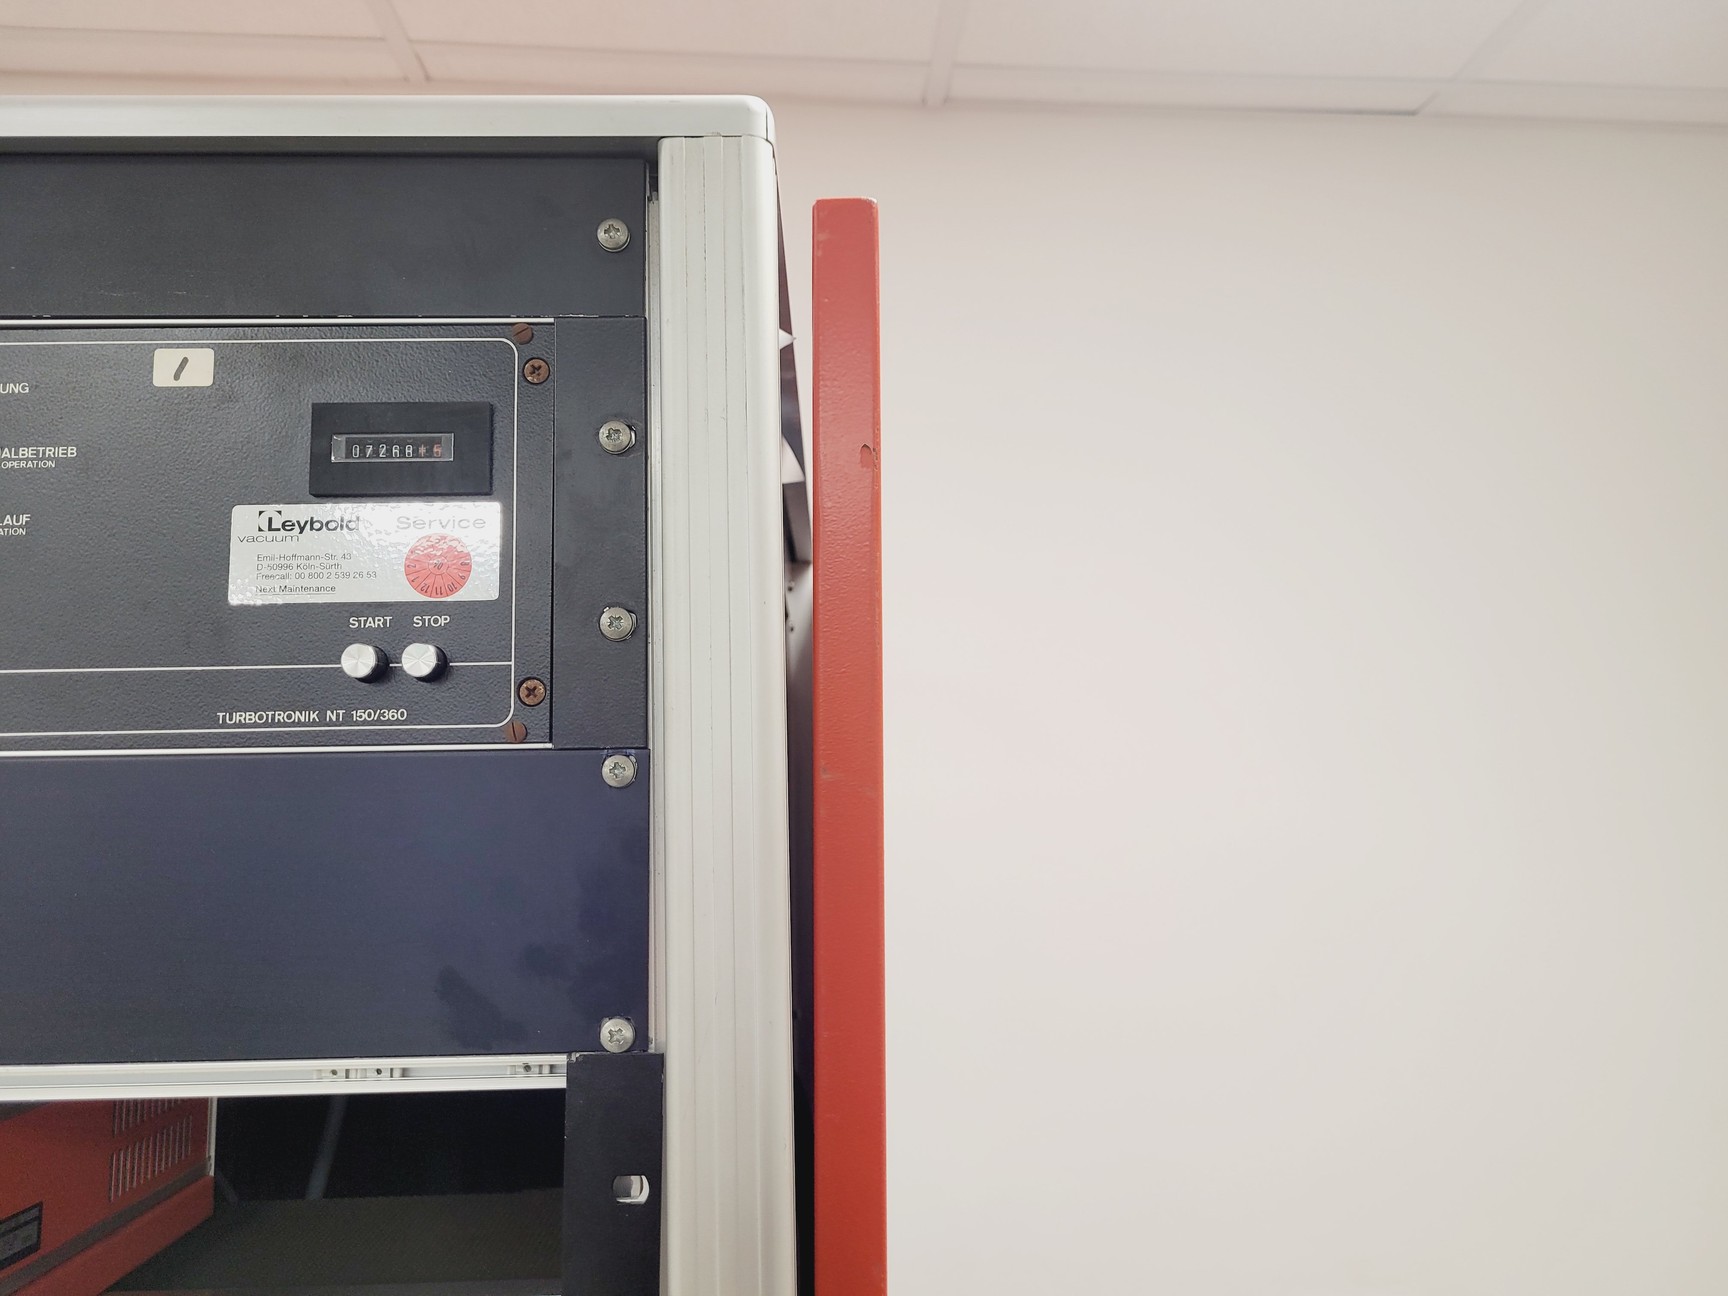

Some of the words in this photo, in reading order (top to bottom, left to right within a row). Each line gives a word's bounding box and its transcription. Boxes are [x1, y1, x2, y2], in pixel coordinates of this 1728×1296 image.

[0, 446, 77, 459] ALBETRIEB
[1, 460, 56, 469] OPERATION
[267, 516, 360, 535] Leybold
[396, 515, 487, 530] Service
[237, 534, 300, 543] vacuum
[256, 553, 339, 562] Emil-Hoffmann-Str.
[340, 552, 352, 561] 43
[256, 563, 294, 571] D-50996
[296, 562, 343, 571] Köln-Sürth
[256, 573, 293, 581] Freecall:
[294, 572, 306, 580] 00
[307, 572, 325, 580] 800
[334, 571, 351, 579] 539
[352, 571, 364, 579] 26
[366, 571, 377, 579] 53
[255, 585, 277, 593] Next
[278, 585, 337, 593] Maintenance
[348, 616, 393, 629] START
[412, 615, 451, 628] STOP
[216, 710, 320, 724] TURBOTRONIK
[325, 709, 346, 723] NT
[350, 708, 408, 722] 150/360
